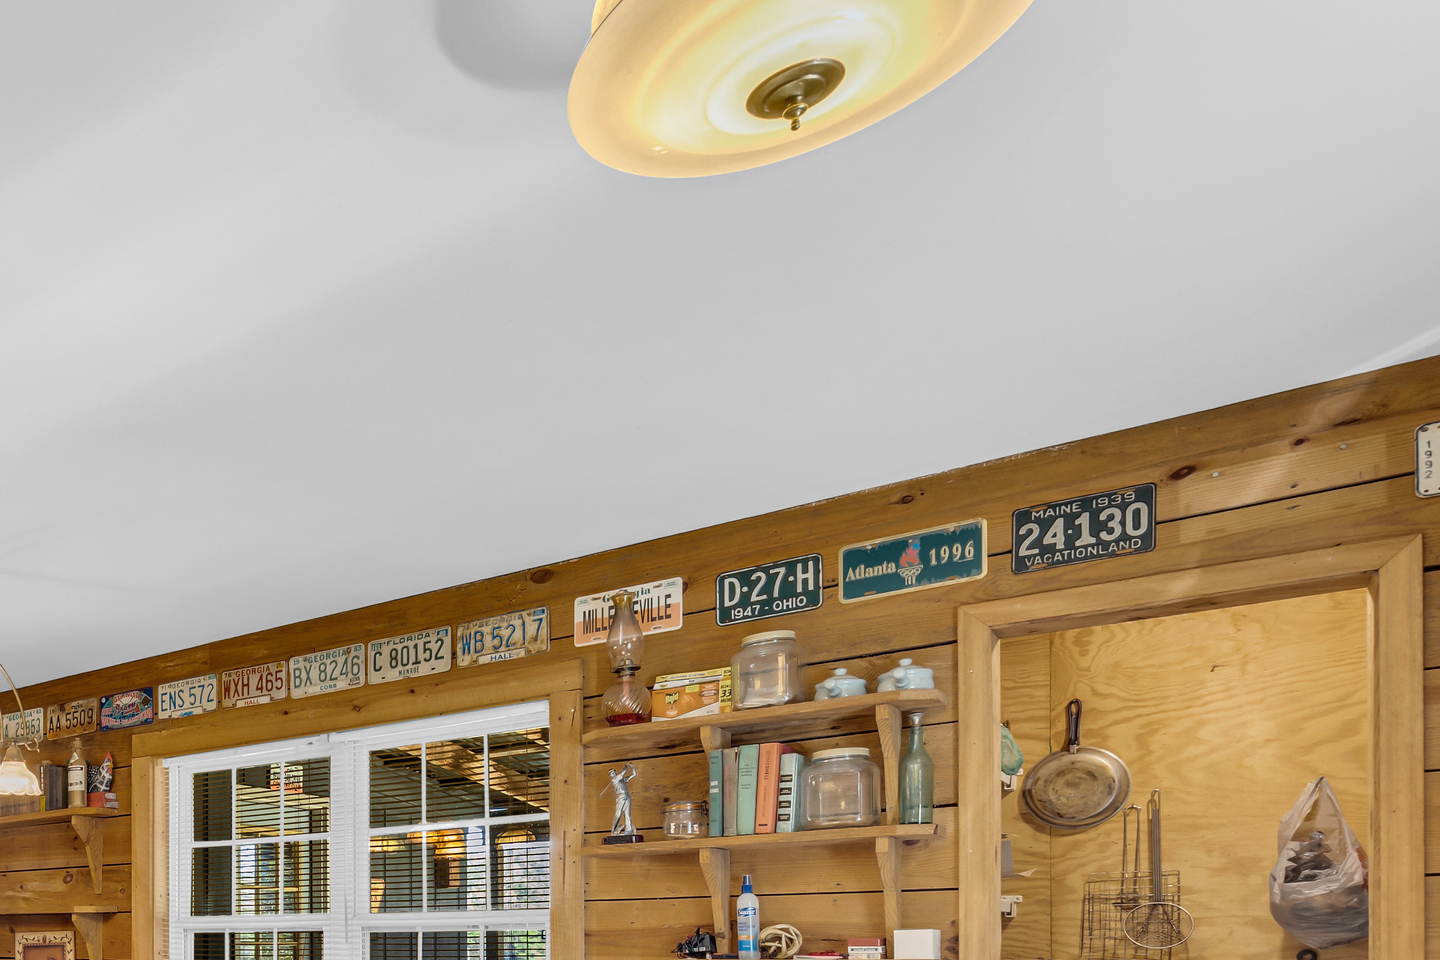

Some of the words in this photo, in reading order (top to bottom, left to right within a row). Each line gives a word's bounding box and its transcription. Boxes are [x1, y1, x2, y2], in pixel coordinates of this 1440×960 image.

[1031, 501, 1082, 521] MAINE
[1092, 491, 1136, 509] 1939
[845, 560, 897, 582] Atlanta
[929, 540, 975, 566] 1996
[1025, 538, 1142, 567] VACATIONLAND
[602, 587, 651, 603] Ggia
[731, 604, 760, 620] 1947
[772, 595, 807, 611] OHIO
[478, 613, 524, 628] GEORGIA
[583, 593, 672, 635] MILLEEVILLE
[386, 632, 431, 647] FLORIDA
[461, 630, 484, 656] WB
[492, 618, 544, 650] 5217
[308, 649, 347, 664] GEORGIA
[373, 651, 382, 673] C
[389, 638, 445, 670] 80152
[490, 652, 514, 661] HALL
[172, 678, 202, 689] GEORGIA
[235, 665, 271, 678] GEORGIA
[293, 664, 312, 689] BX
[318, 655, 360, 683] 8246
[398, 666, 420, 676] MONROE
[223, 675, 250, 700] WXH
[256, 669, 284, 693] 465
[319, 683, 337, 691] COBB
[161, 689, 185, 712] ENS
[189, 683, 214, 706] 572
[49, 714, 61, 734] AA
[65, 708, 94, 730] 5509
